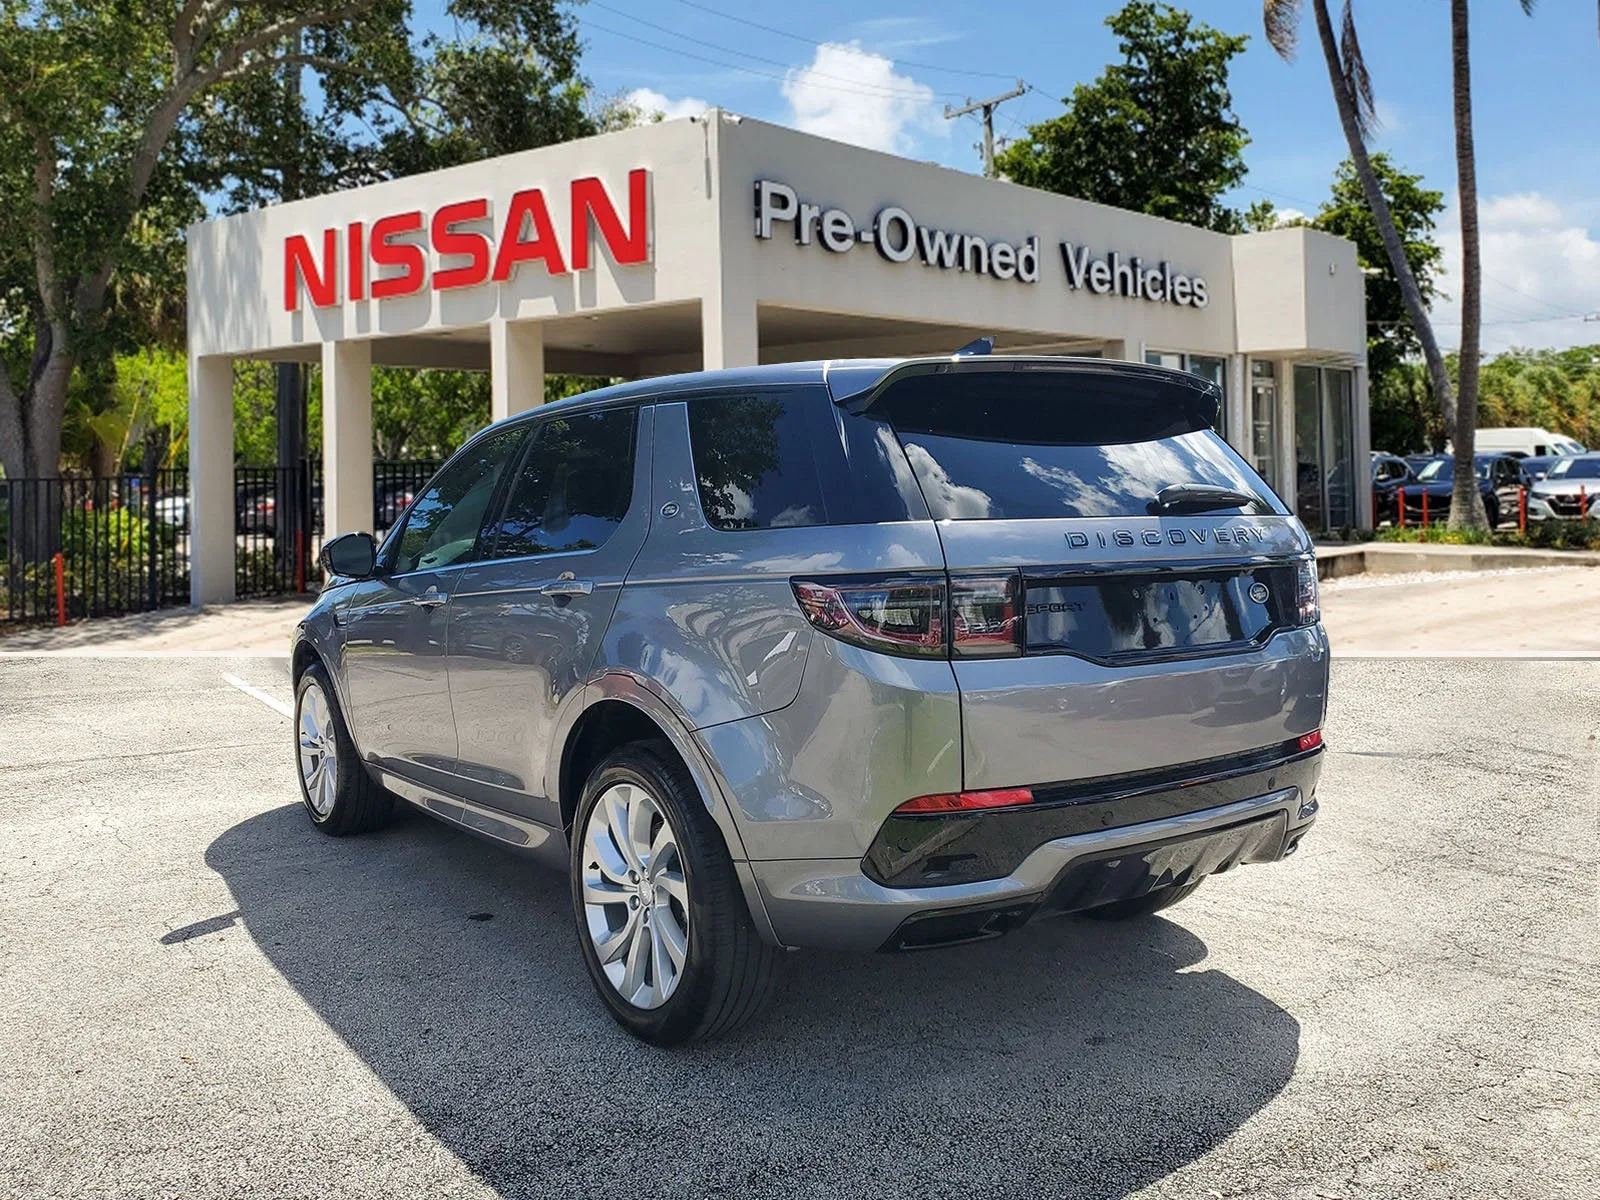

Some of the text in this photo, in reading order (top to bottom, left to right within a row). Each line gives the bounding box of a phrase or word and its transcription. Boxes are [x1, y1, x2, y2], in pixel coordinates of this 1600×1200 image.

[284, 168, 648, 312] NISSAN
[755, 179, 1209, 309] Pre-Owned Vehicles
[1065, 528, 1266, 550] DISCOVERY
